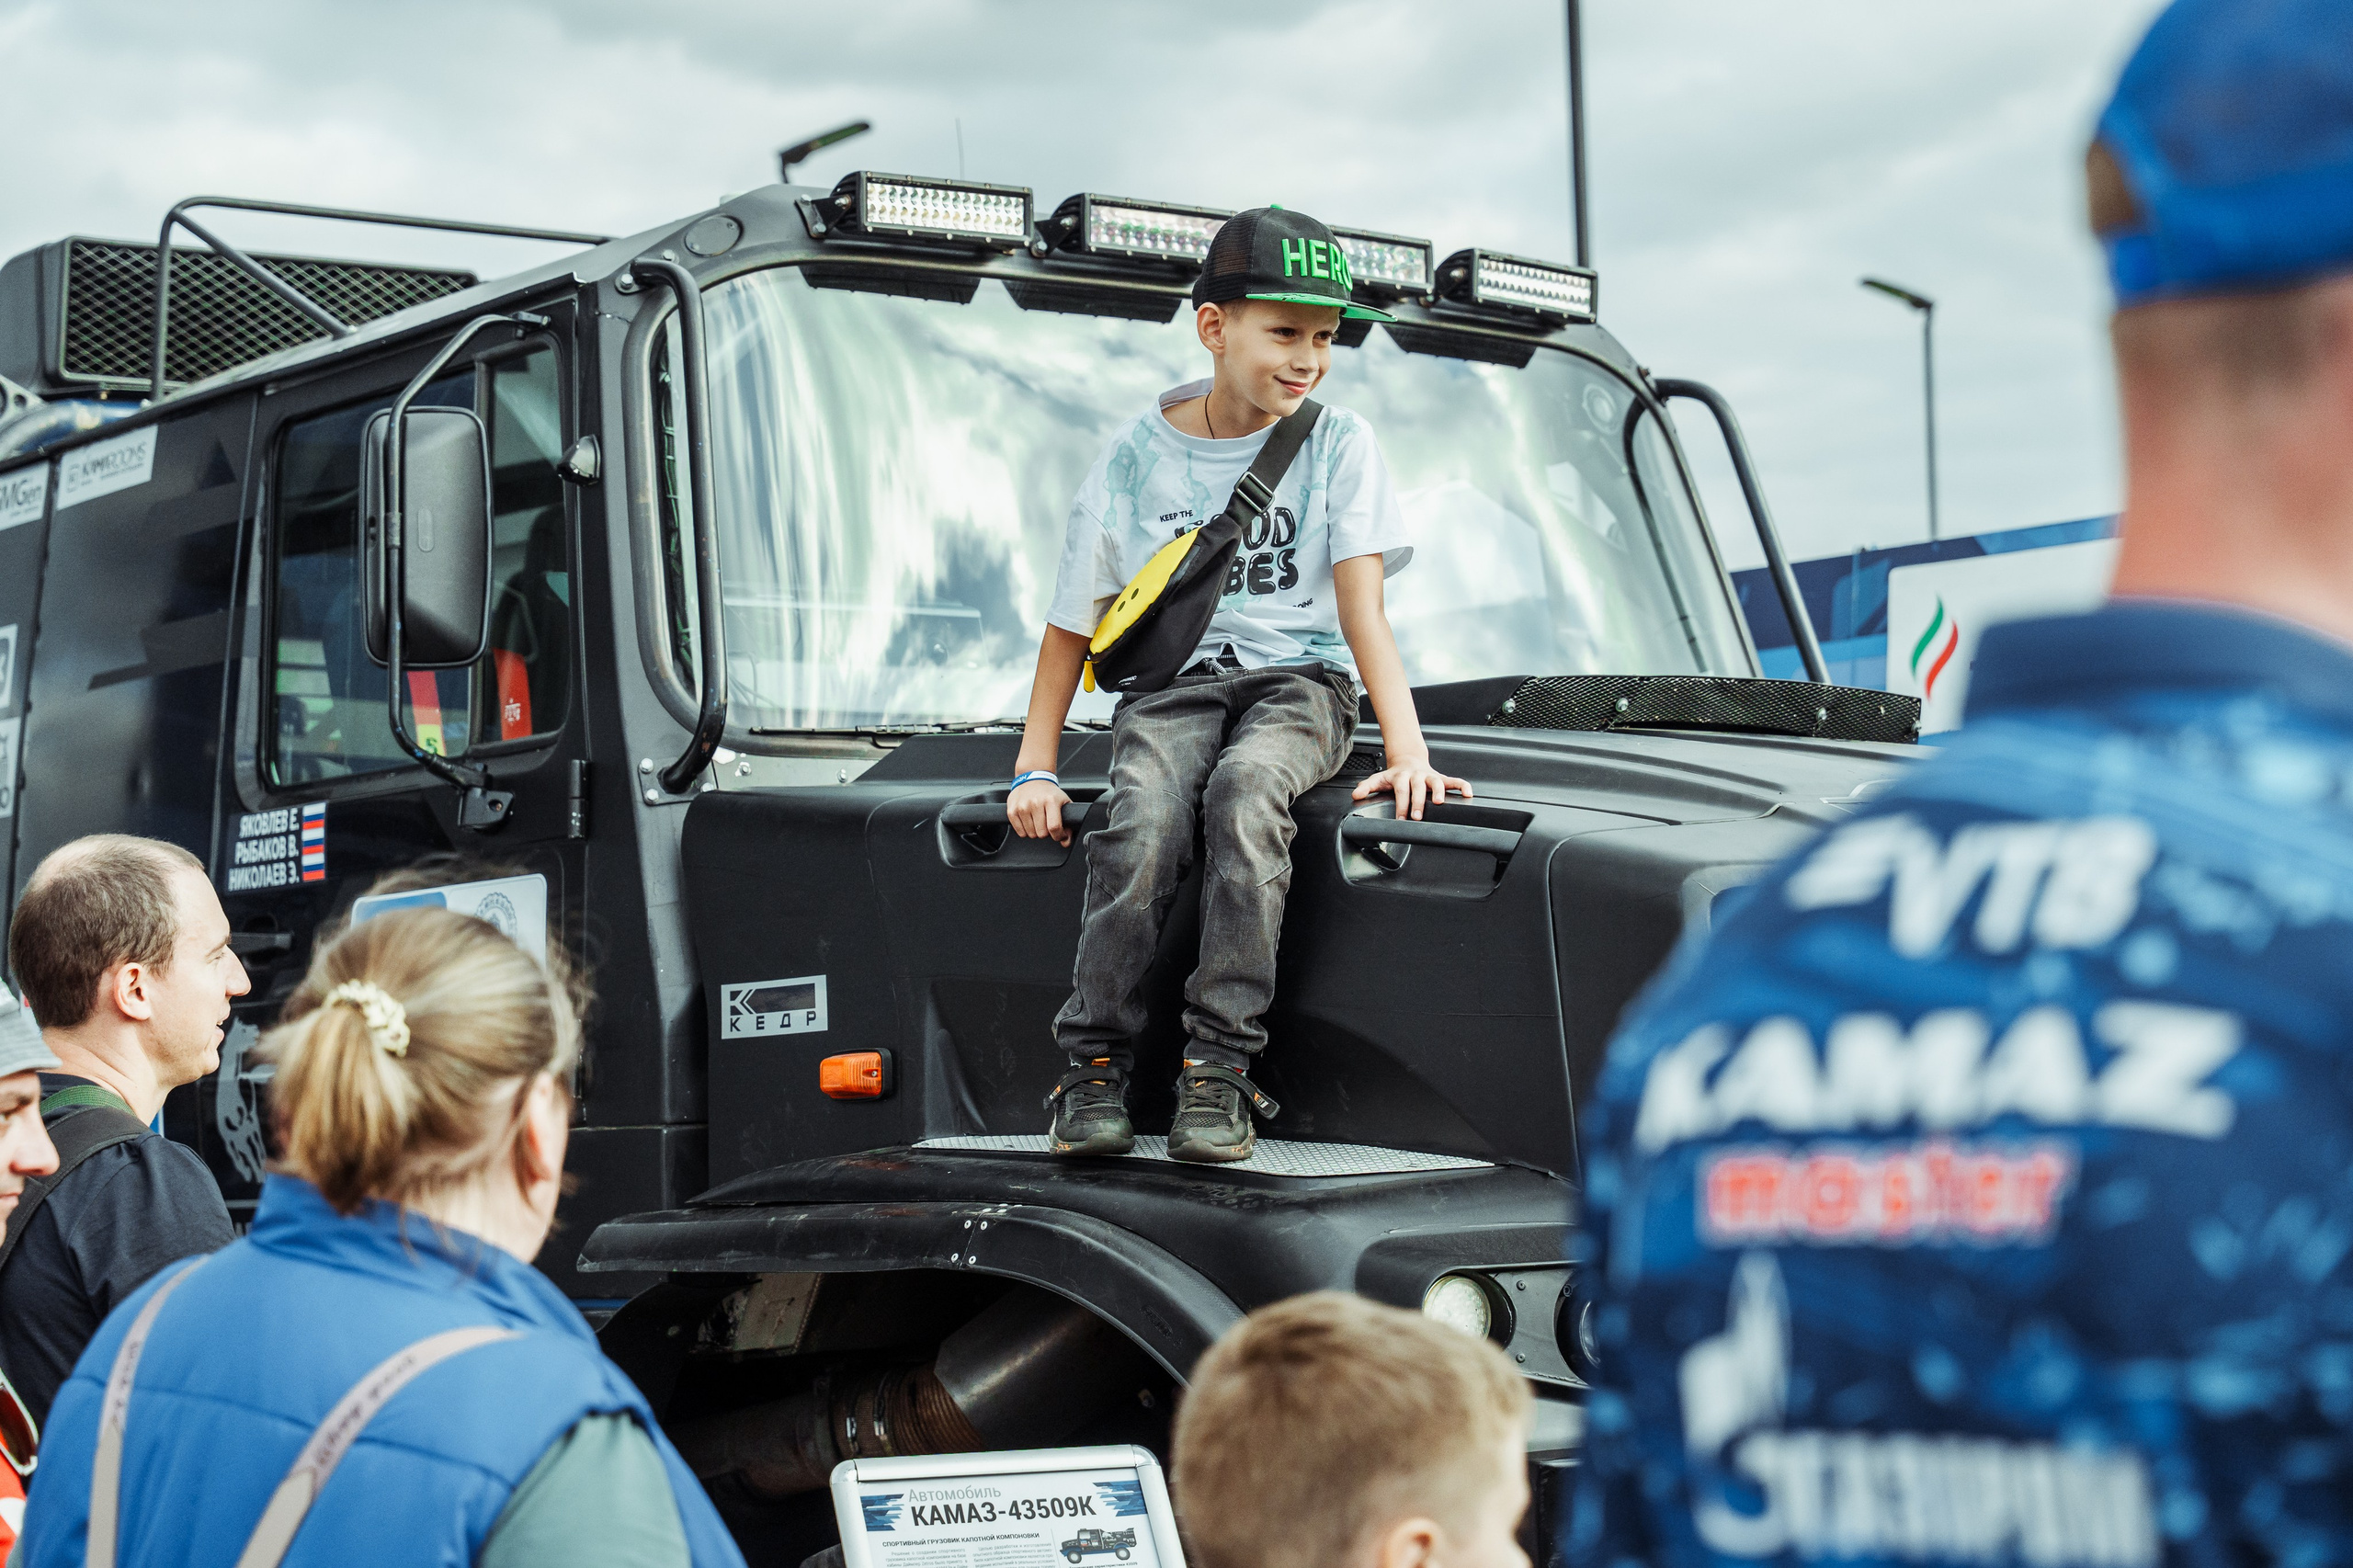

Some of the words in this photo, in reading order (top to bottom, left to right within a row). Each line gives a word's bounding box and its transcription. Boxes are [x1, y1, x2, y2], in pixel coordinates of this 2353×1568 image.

[1281, 237, 1353, 292] HERO
[1159, 512, 1178, 523] KEEP
[1178, 509, 1194, 518] THE
[1175, 506, 1297, 551] OD
[1223, 548, 1299, 596] BES
[239, 809, 289, 838] ЯКОВЛЕВ
[234, 835, 287, 865] РЫБАКОВ
[228, 862, 287, 892] НИКОЛАЕВ
[730, 1010, 817, 1032] КЕДР
[1634, 1000, 2243, 1155] KAMAZ
[908, 1485, 1002, 1502] Автомобиль
[911, 1495, 1097, 1527] КАМАЗ-43509К
[882, 1539, 926, 1548] СПОРТИВНЫЙ
[926, 1537, 961, 1545] ГРУЗОВИК
[961, 1534, 995, 1543] КАПОТНОЙ
[996, 1532, 1040, 1540] КОМПОНОВКИ
